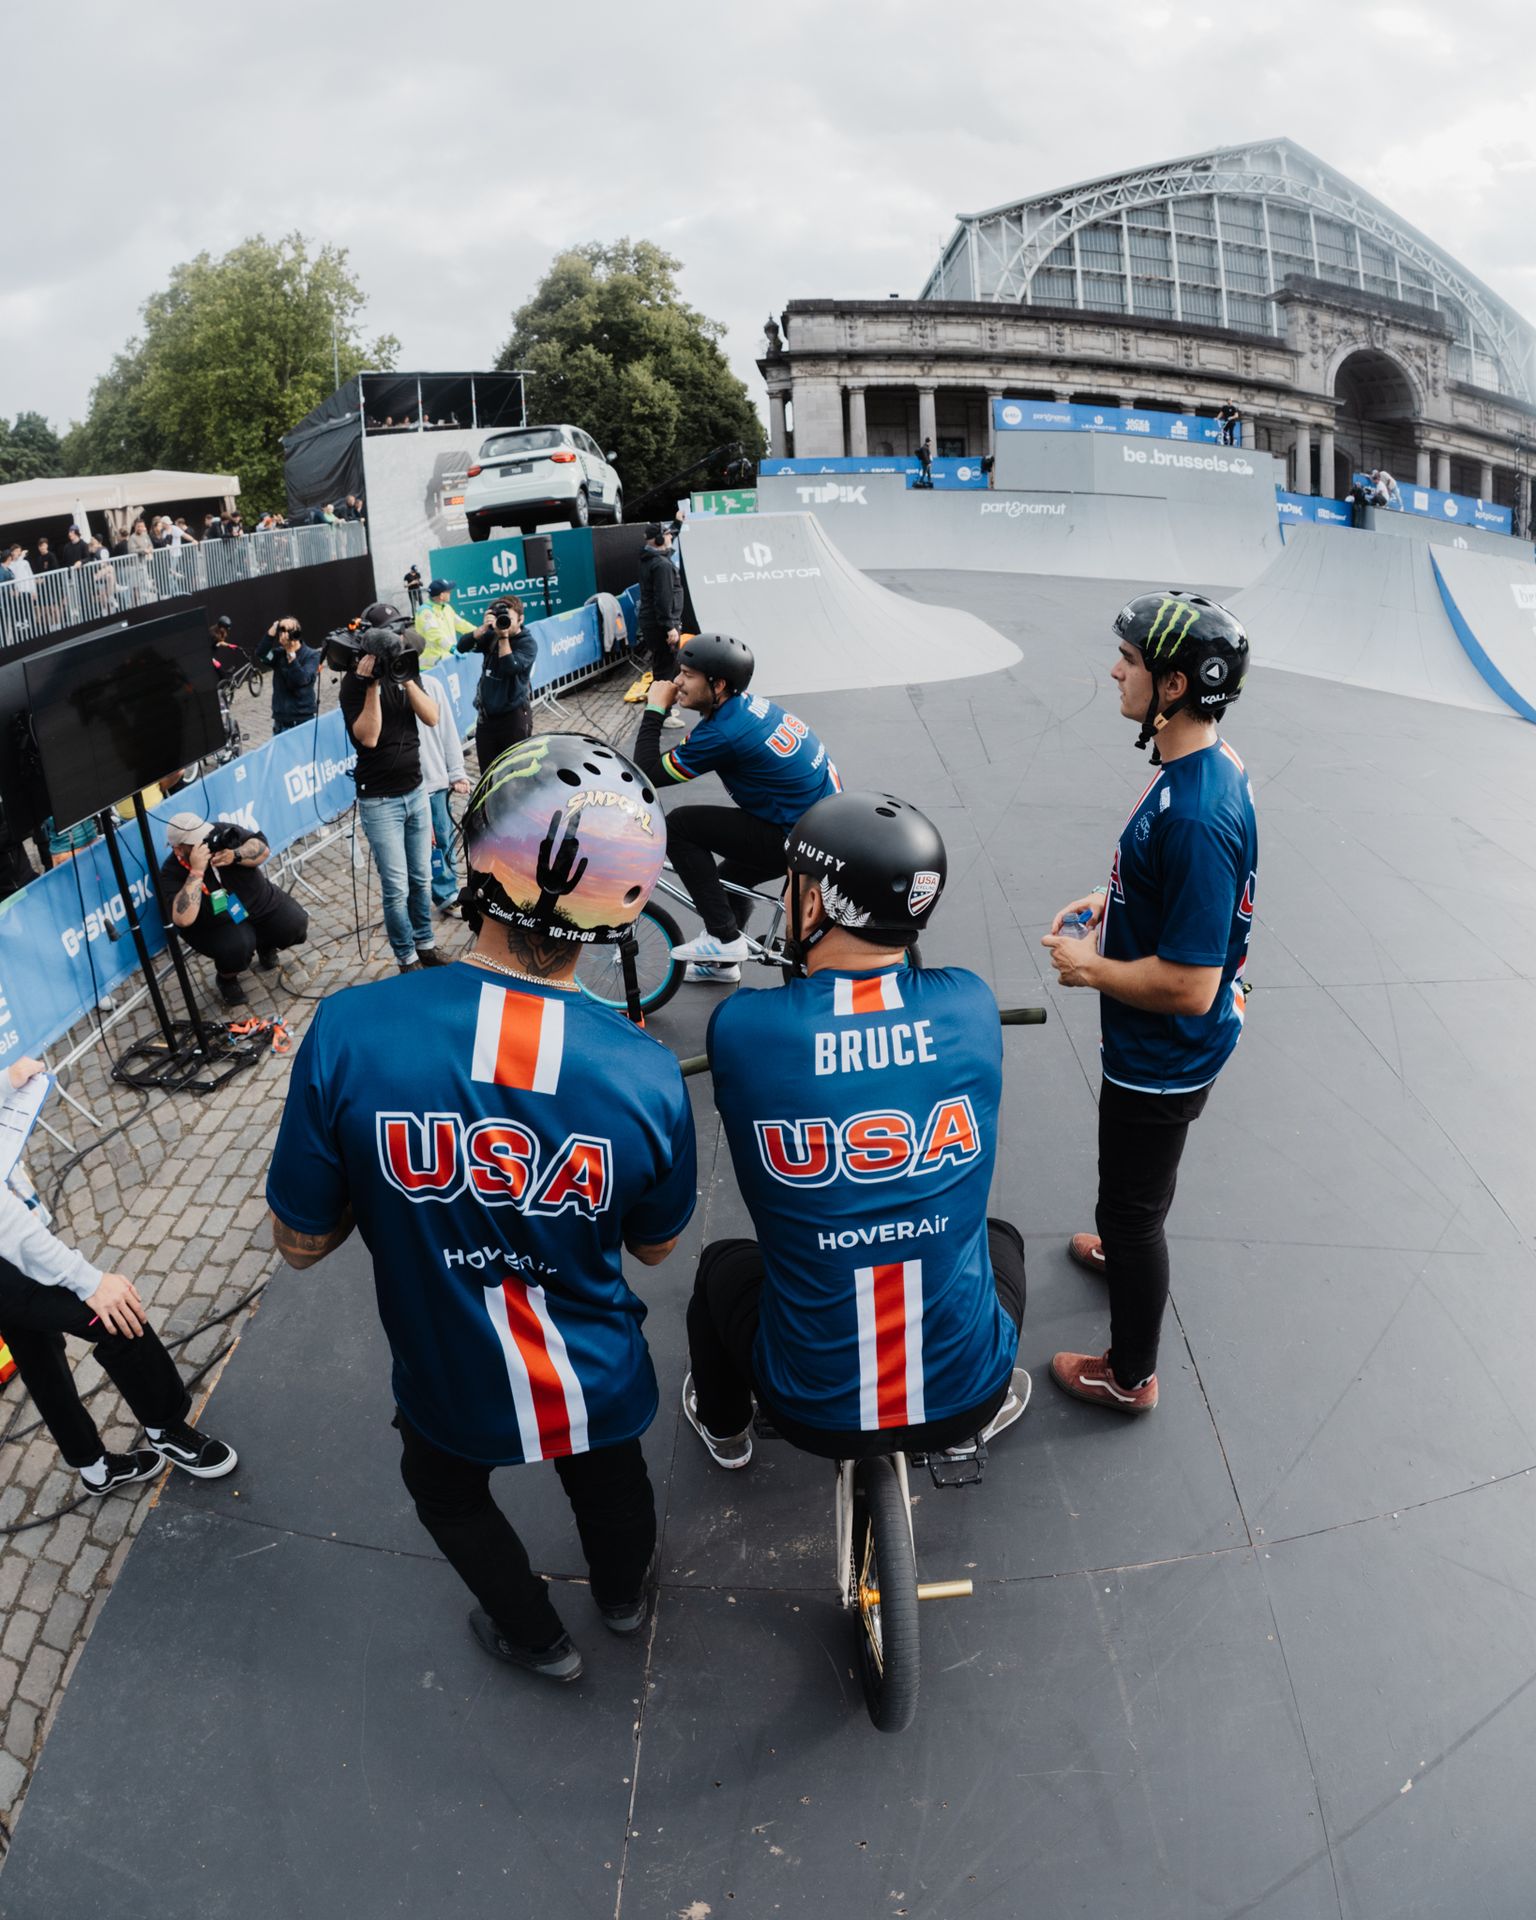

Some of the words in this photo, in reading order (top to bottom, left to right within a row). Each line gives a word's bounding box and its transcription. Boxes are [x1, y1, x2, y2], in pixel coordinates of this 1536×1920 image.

[981, 501, 1066, 518] part&namut
[703, 567, 821, 585] LEAPMOTOR
[797, 840, 846, 872] HUFFY
[917, 876, 937, 886] USA
[548, 926, 597, 943] 10-11-09
[815, 1019, 937, 1076] BRUCE
[753, 1094, 982, 1189] USA
[375, 1111, 614, 1222] USA
[817, 1215, 949, 1250] HOVERAir
